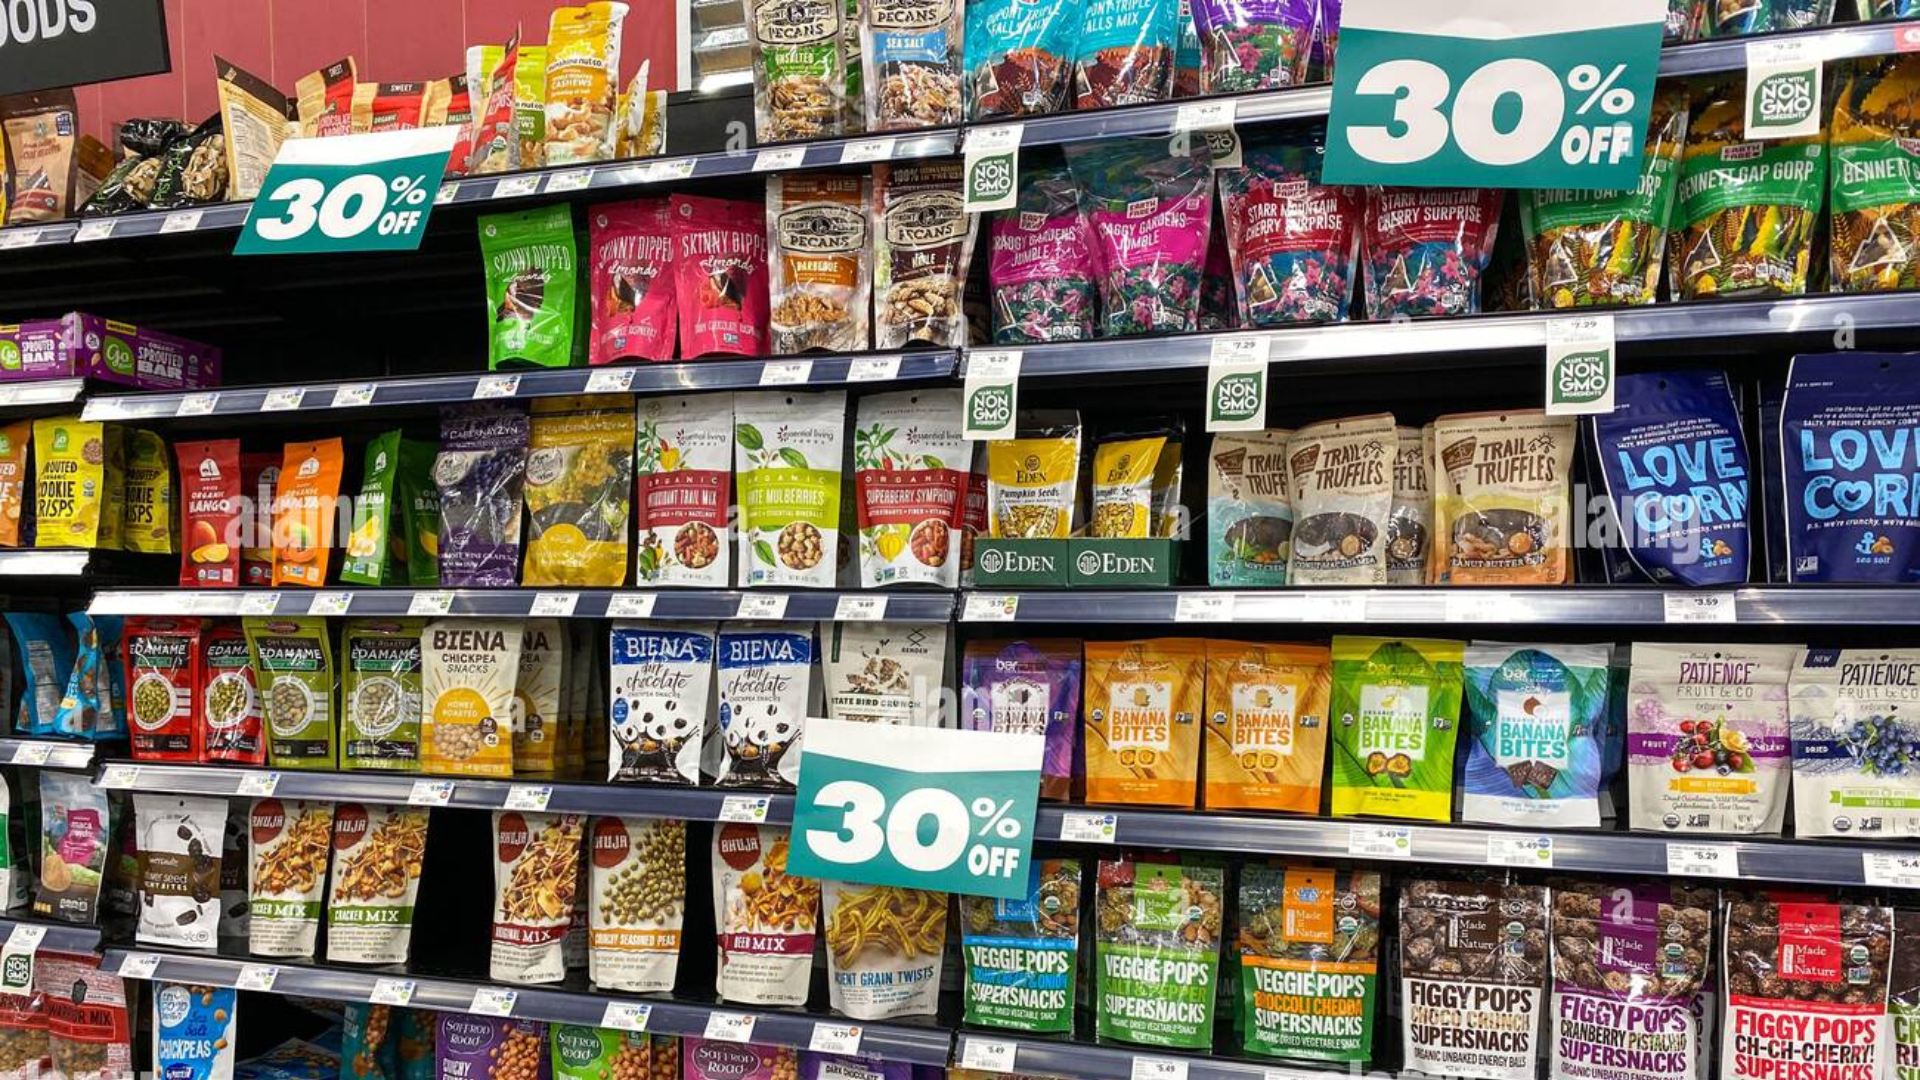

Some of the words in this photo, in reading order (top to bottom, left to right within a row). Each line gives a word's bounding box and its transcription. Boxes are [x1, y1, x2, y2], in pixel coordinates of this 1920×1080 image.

[0, 0, 97, 46] ODS
[877, 8, 938, 23] PECANS
[768, 23, 824, 40] PECANS
[886, 37, 903, 49] SEA
[904, 37, 925, 49] SALT
[552, 78, 592, 90] CASHEWS
[1762, 82, 1810, 99] NON
[1760, 98, 1812, 114] GMO
[1560, 125, 1634, 165] OFF
[974, 163, 1010, 181] NON
[1738, 165, 1770, 184] GAP
[1772, 161, 1815, 182] GORP
[973, 176, 1011, 193] GMO
[1248, 204, 1277, 220] STARR
[1280, 199, 1338, 218] MOUNTAIN
[378, 211, 422, 236] OFF
[1139, 212, 1187, 235] GARDENS
[1245, 219, 1281, 242] CHERRY
[1285, 213, 1343, 232] SURPRISE
[1377, 211, 1421, 231] CHERRY
[1423, 207, 1482, 223] SURPRISE
[681, 231, 730, 257] SKINNY
[790, 234, 850, 249] PECANS
[494, 249, 530, 274] SKINNY
[532, 243, 572, 271] DIPPED
[1011, 244, 1050, 267] JUMBLE
[22, 338, 55, 352] SPROUTED
[22, 350, 56, 363] BAR
[137, 345, 184, 368] SPROUTED
[137, 360, 183, 381] BAR
[1560, 362, 1604, 379] NON
[1218, 382, 1257, 399] NON
[1558, 376, 1606, 393] GMO
[974, 395, 1009, 411] NON
[1216, 396, 1258, 413] GMO
[973, 408, 1009, 422] GMO
[1323, 442, 1362, 468] TRAIL
[1480, 438, 1528, 461] TRAIL
[1474, 454, 1556, 485] TRUFFLES
[1618, 437, 1744, 490] LOVE
[1015, 470, 1048, 484] EDEN
[1316, 459, 1384, 491] TRUFFLES
[766, 489, 825, 506] MULBERRIES
[1000, 487, 1036, 499] Pumpkin
[1037, 486, 1059, 498] Seeds
[1004, 550, 1055, 571] EDEN
[1103, 553, 1155, 574] EDEN
[433, 630, 506, 651] BIENA
[625, 637, 696, 658] BIENA
[130, 643, 186, 656] EDAMAME
[259, 648, 322, 660] EDAMAME
[352, 649, 419, 660] EDAMAME
[729, 639, 795, 662] BIENA
[441, 653, 497, 665] CHICKPEA
[1813, 655, 1832, 663] NEW
[446, 664, 489, 674] SNACKS
[1679, 661, 1753, 684] PATIENCE
[1840, 663, 1918, 686] PATIENCE
[1677, 685, 1716, 698] FRUIT
[1736, 685, 1754, 697] CO
[1838, 686, 1879, 698] FRUIT
[1900, 687, 1919, 698] CO
[446, 700, 475, 710] HONEY
[855, 698, 879, 707] BIRD
[441, 708, 478, 719] ROASTED
[994, 709, 1046, 726] BANANA
[1112, 711, 1171, 728] BANANA
[1236, 712, 1291, 730] BANANA
[1362, 715, 1424, 733] BANANA
[1500, 721, 1566, 741] BANANA
[1111, 725, 1167, 743] BITES
[1235, 727, 1291, 745] BITES
[1361, 731, 1423, 750] BITES
[1500, 738, 1566, 759] BITES
[1642, 739, 1668, 749] FRUIT
[1805, 745, 1829, 754] DRIED
[721, 837, 760, 854] BHUJA
[967, 845, 1021, 878] OFF
[163, 873, 188, 885] seed
[274, 903, 307, 918] MIX
[334, 909, 364, 922] CRACKER
[366, 909, 399, 922] MIX
[1296, 908, 1322, 921] Made
[1295, 927, 1329, 939] Nature
[1459, 919, 1487, 931] Made
[521, 929, 551, 944] MIX
[733, 937, 751, 949] BEER
[752, 937, 786, 951] MIX
[1458, 938, 1494, 951] Nature
[1613, 937, 1644, 951] Made
[1795, 943, 1827, 956] Made
[6, 960, 29, 974] NON
[970, 946, 1026, 972] VEGGIE
[1027, 948, 1070, 973] POPS
[5, 968, 29, 982] GMO
[1104, 953, 1161, 983] VEGGIE
[1162, 958, 1209, 986] POPS
[1795, 963, 1837, 977] Nature
[1253, 967, 1315, 997] VEGGIE
[1316, 972, 1366, 998] POPS
[970, 982, 1066, 1009] SUPERSNACKS
[1410, 981, 1472, 1009] FIGGY
[1473, 985, 1533, 1014] POPS
[91, 1008, 112, 1026] MIX
[1104, 996, 1206, 1024] SUPERSNACKS
[1559, 995, 1625, 1030] FIGGY
[1626, 1002, 1688, 1033] POPS
[1178, 1025, 1197, 1035] SNACK
[1254, 1009, 1363, 1037] SUPERSNACKS
[1734, 1010, 1810, 1041] FIGGY
[1812, 1016, 1876, 1044] POPS
[450, 1033, 482, 1046] Road
[1255, 1031, 1279, 1043] ORGANIC
[1279, 1033, 1300, 1046] DRIED
[1300, 1036, 1341, 1049] VEGETABLE
[1341, 1039, 1361, 1050] SNACK
[1410, 1023, 1530, 1053] SUPERSNACKS
[561, 1047, 592, 1060] Road
[1558, 1038, 1688, 1074] SUPERSNACKS
[1734, 1033, 1875, 1063] CH-CH-CHERRY!
[1414, 1047, 1441, 1062] ORGANIC
[1442, 1051, 1478, 1065] UNBAKED
[1478, 1053, 1508, 1068] ENERGY
[1509, 1056, 1527, 1068] BALLS
[708, 1061, 745, 1075] Road
[826, 1064, 842, 1075] DARK
